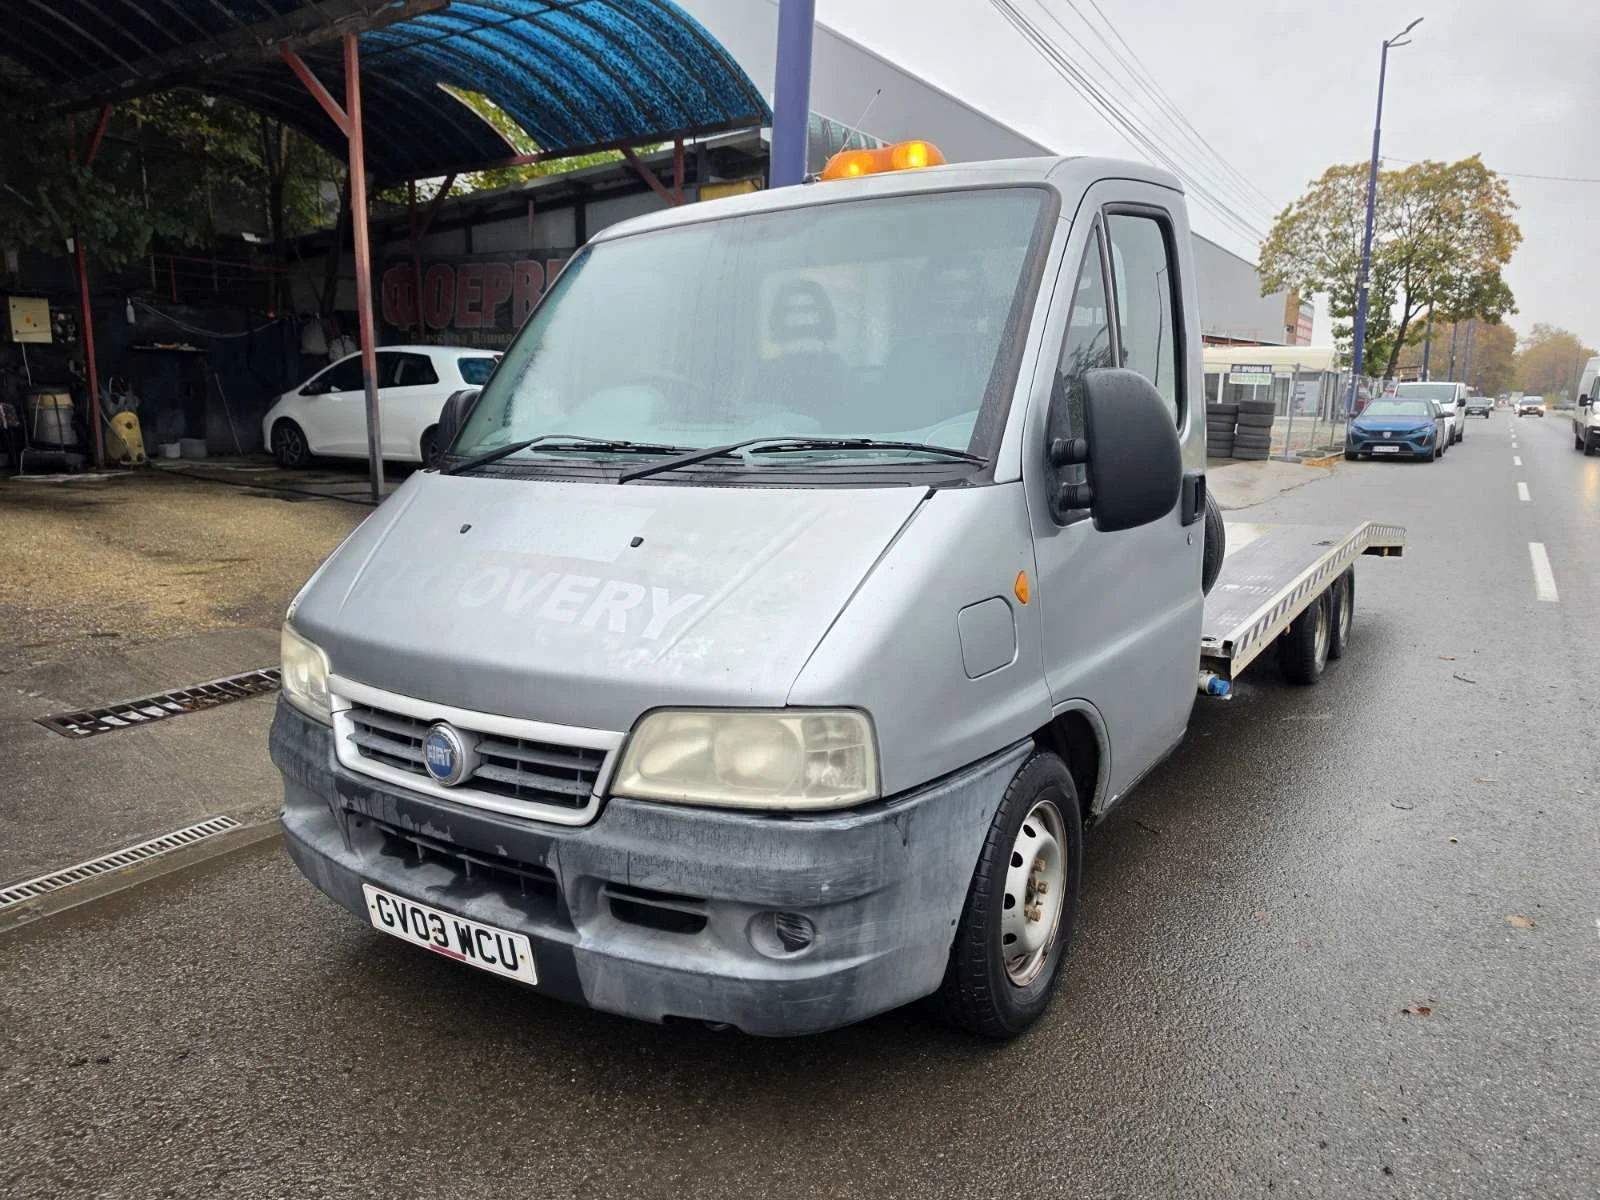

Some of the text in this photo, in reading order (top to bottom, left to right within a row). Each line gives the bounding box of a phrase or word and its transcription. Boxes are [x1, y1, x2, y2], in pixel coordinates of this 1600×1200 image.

[426, 744, 452, 766] FIAT
[375, 894, 519, 971] GV03 WCU
